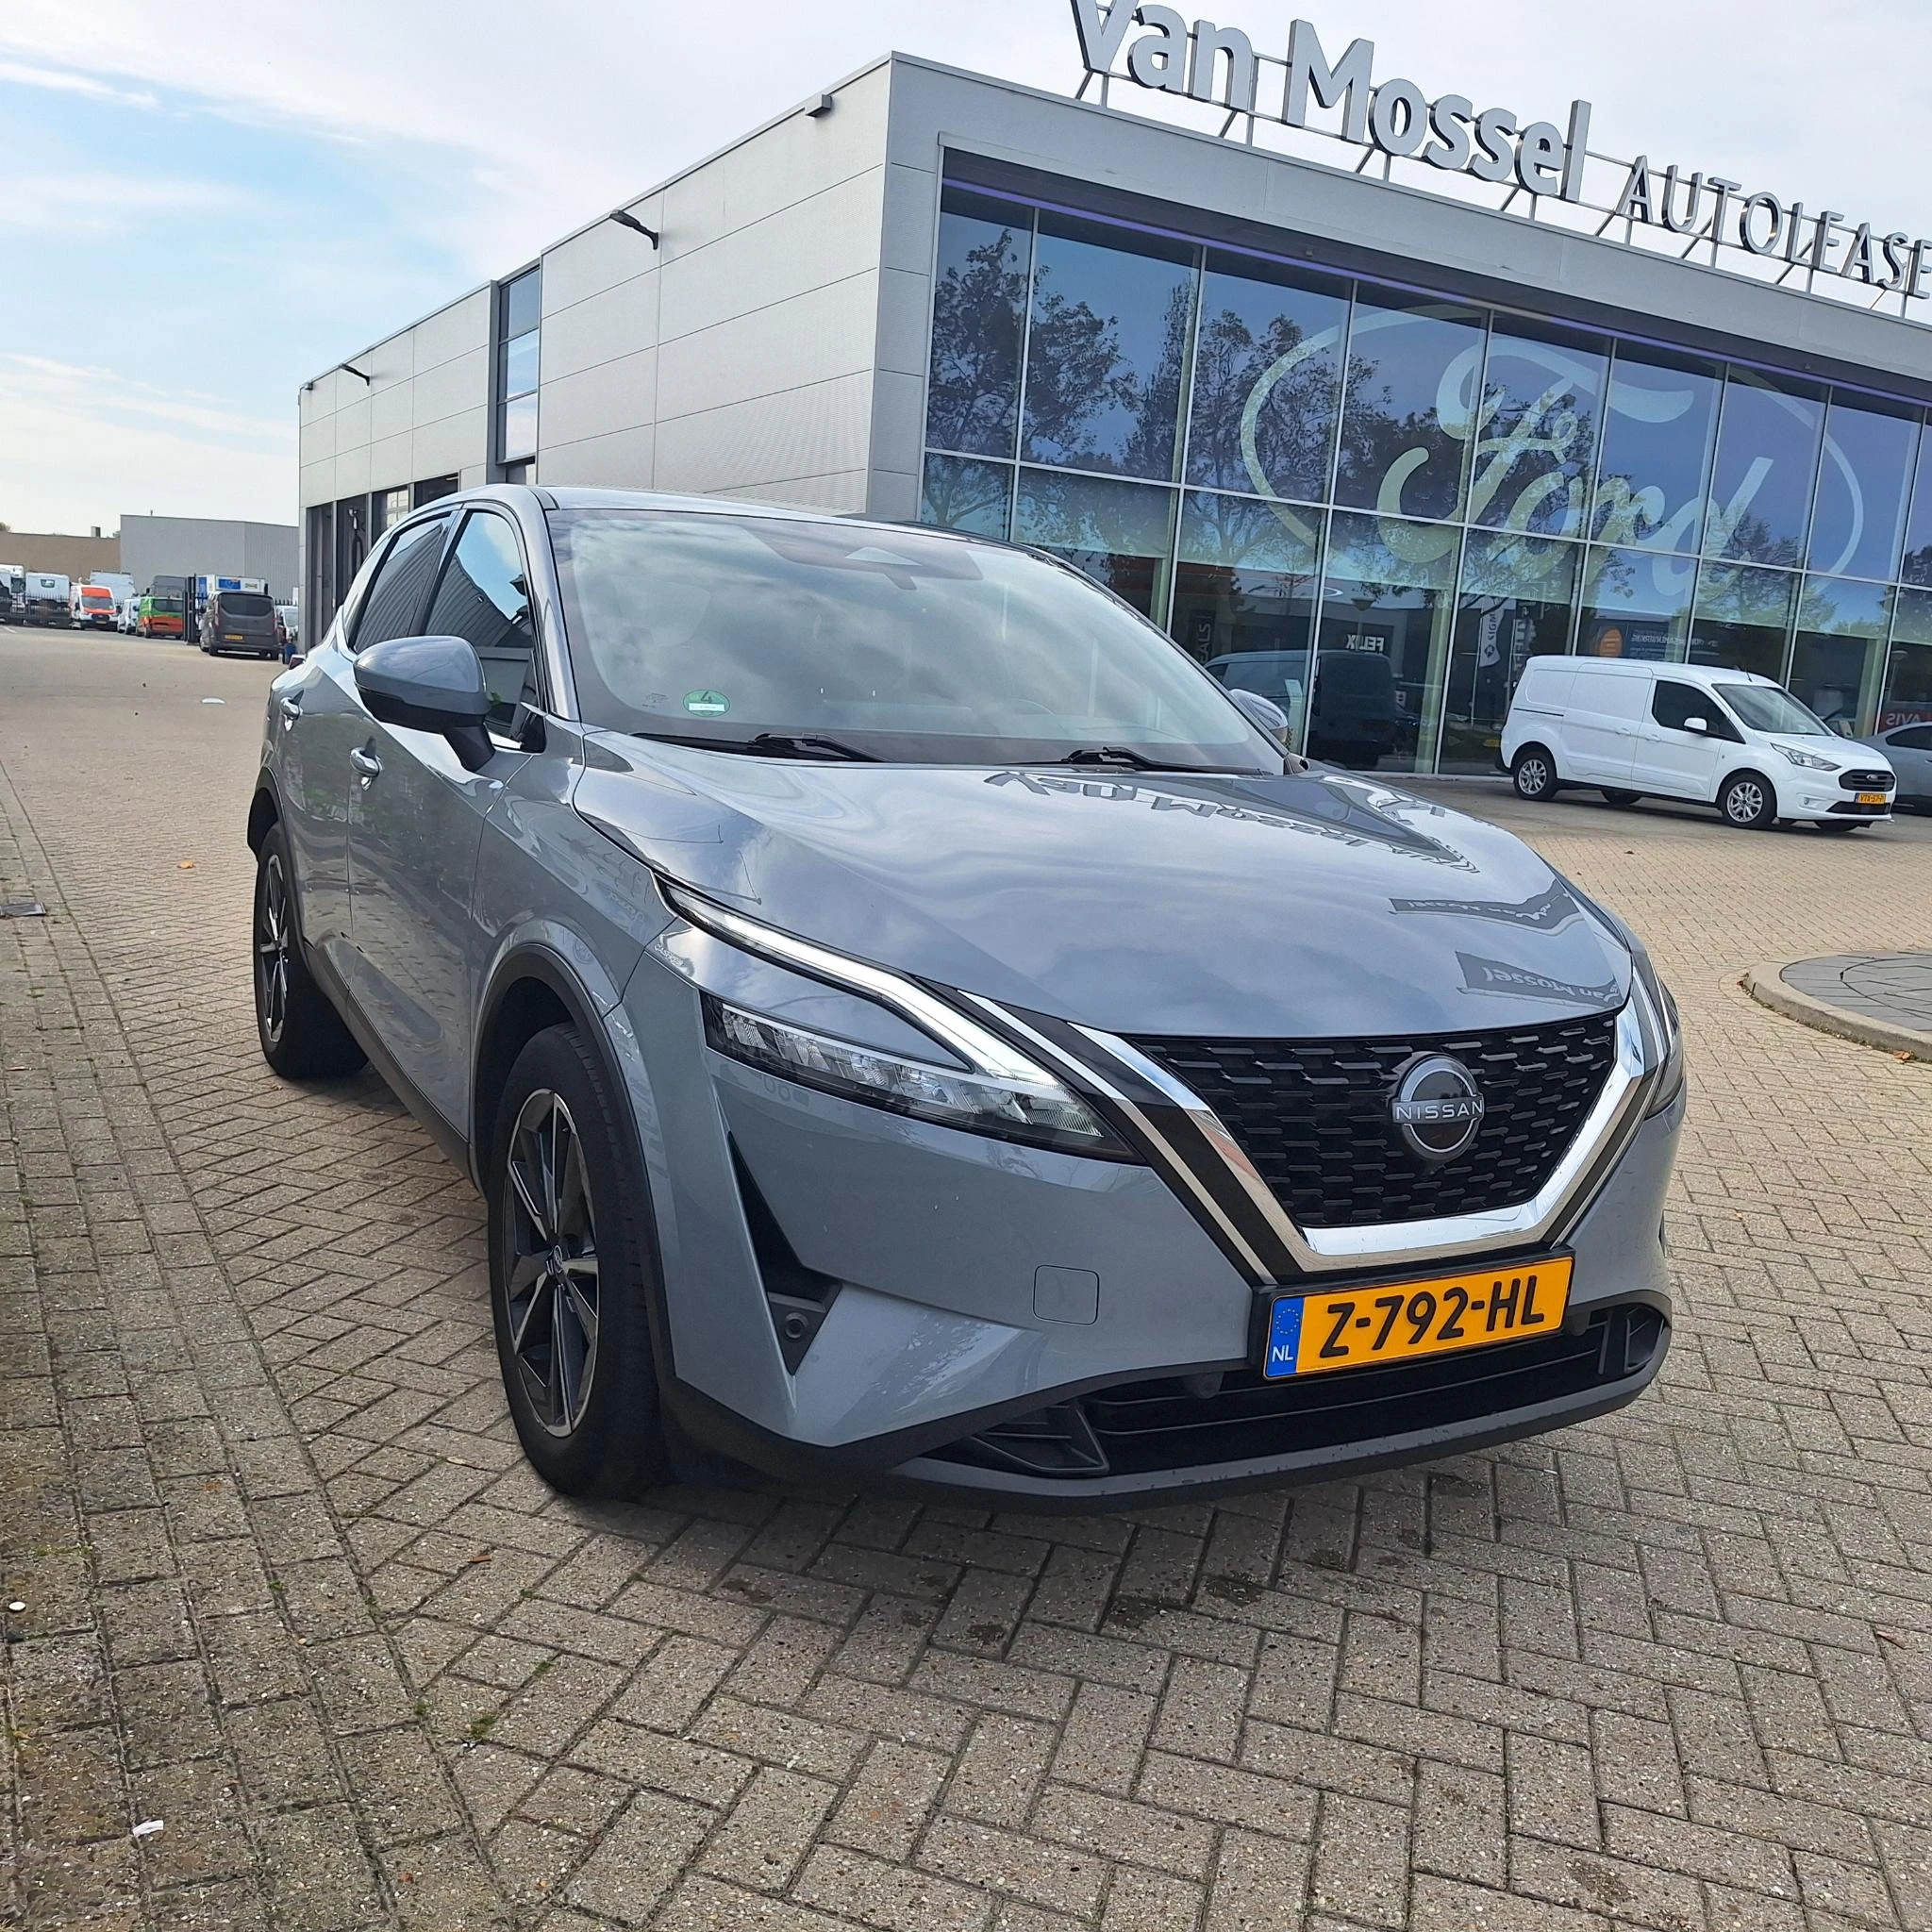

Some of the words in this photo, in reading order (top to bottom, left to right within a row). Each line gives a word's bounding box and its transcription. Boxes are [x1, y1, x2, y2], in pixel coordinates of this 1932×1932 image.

[1070, 0, 1253, 112] Van
[1281, 19, 1591, 204] Mossel
[1615, 155, 1932, 300] AUTOLEASE
[1377, 339, 1774, 598] Ford
[1394, 1098, 1484, 1121] NISSAN
[1271, 1345, 1294, 1362] NL
[1319, 1274, 1545, 1359] Z-792-HL
